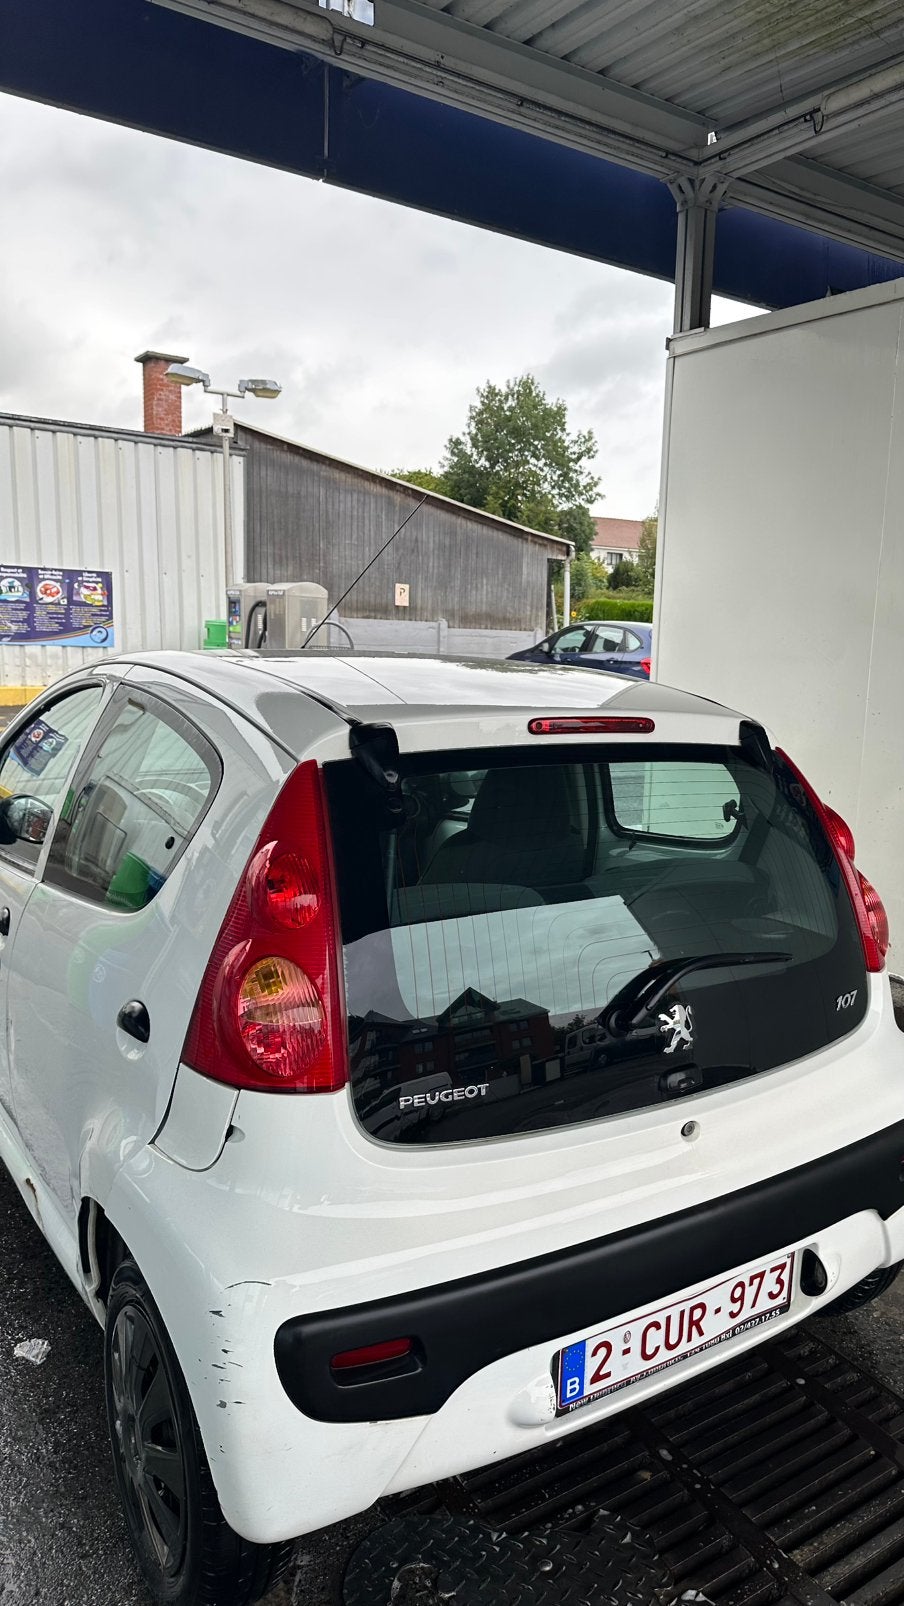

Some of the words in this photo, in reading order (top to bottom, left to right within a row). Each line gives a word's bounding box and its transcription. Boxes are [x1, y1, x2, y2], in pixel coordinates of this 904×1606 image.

[836, 989, 858, 1012] 107
[398, 1083, 490, 1110] PEUGEOT
[589, 1261, 788, 1386] 2-CUR-973
[566, 1376, 580, 1399] B
